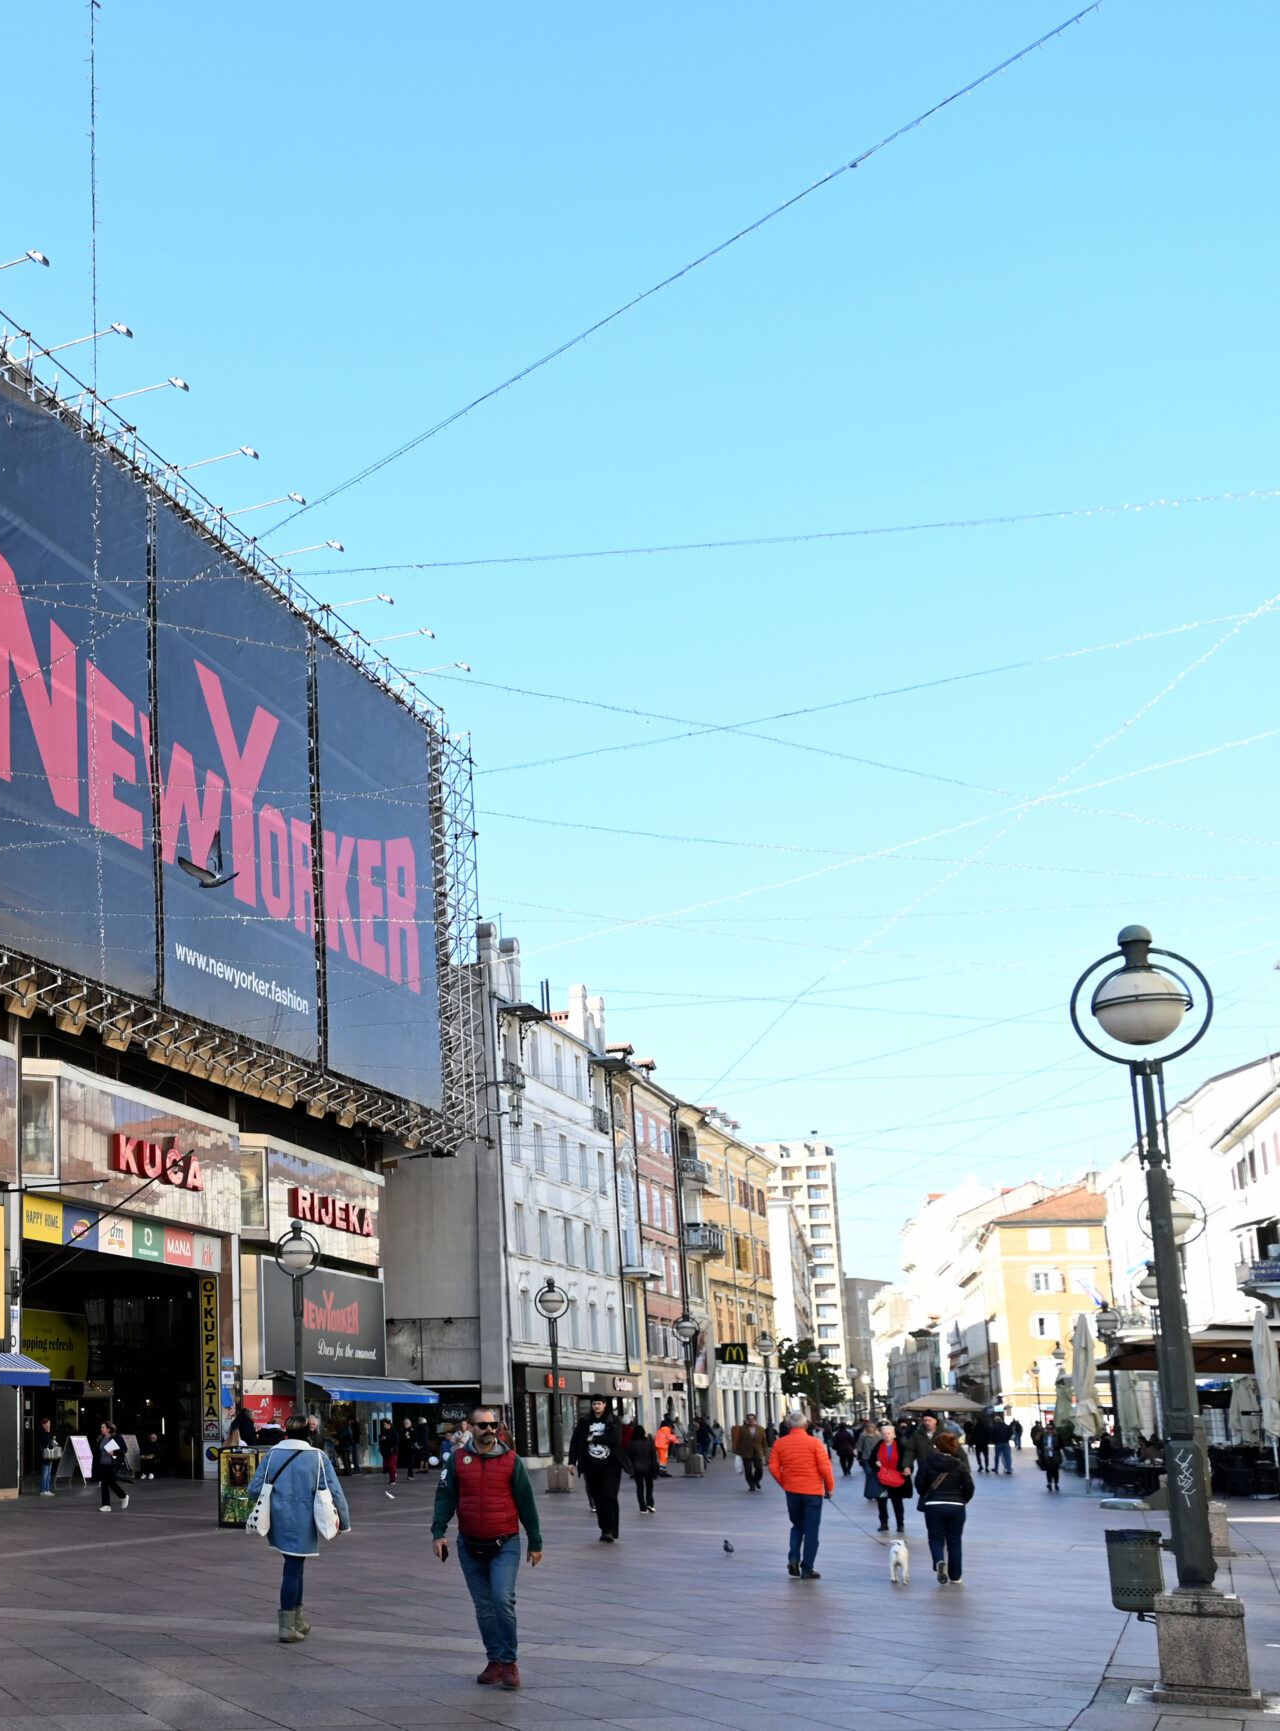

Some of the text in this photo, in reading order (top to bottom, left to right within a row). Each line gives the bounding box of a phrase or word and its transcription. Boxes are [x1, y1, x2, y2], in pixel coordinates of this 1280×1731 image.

[175, 942, 309, 1015] www.newyorker.fashion
[112, 1134, 204, 1192] KUĆA
[26, 1209, 43, 1225] HAPPY
[288, 1187, 375, 1237] RIJEKA
[110, 1221, 124, 1239] dm
[167, 1238, 191, 1257] MANA
[49, 1337, 74, 1351] refresh
[203, 1280, 218, 1418] OTKUP ZLATA
[345, 1343, 353, 1358] the
